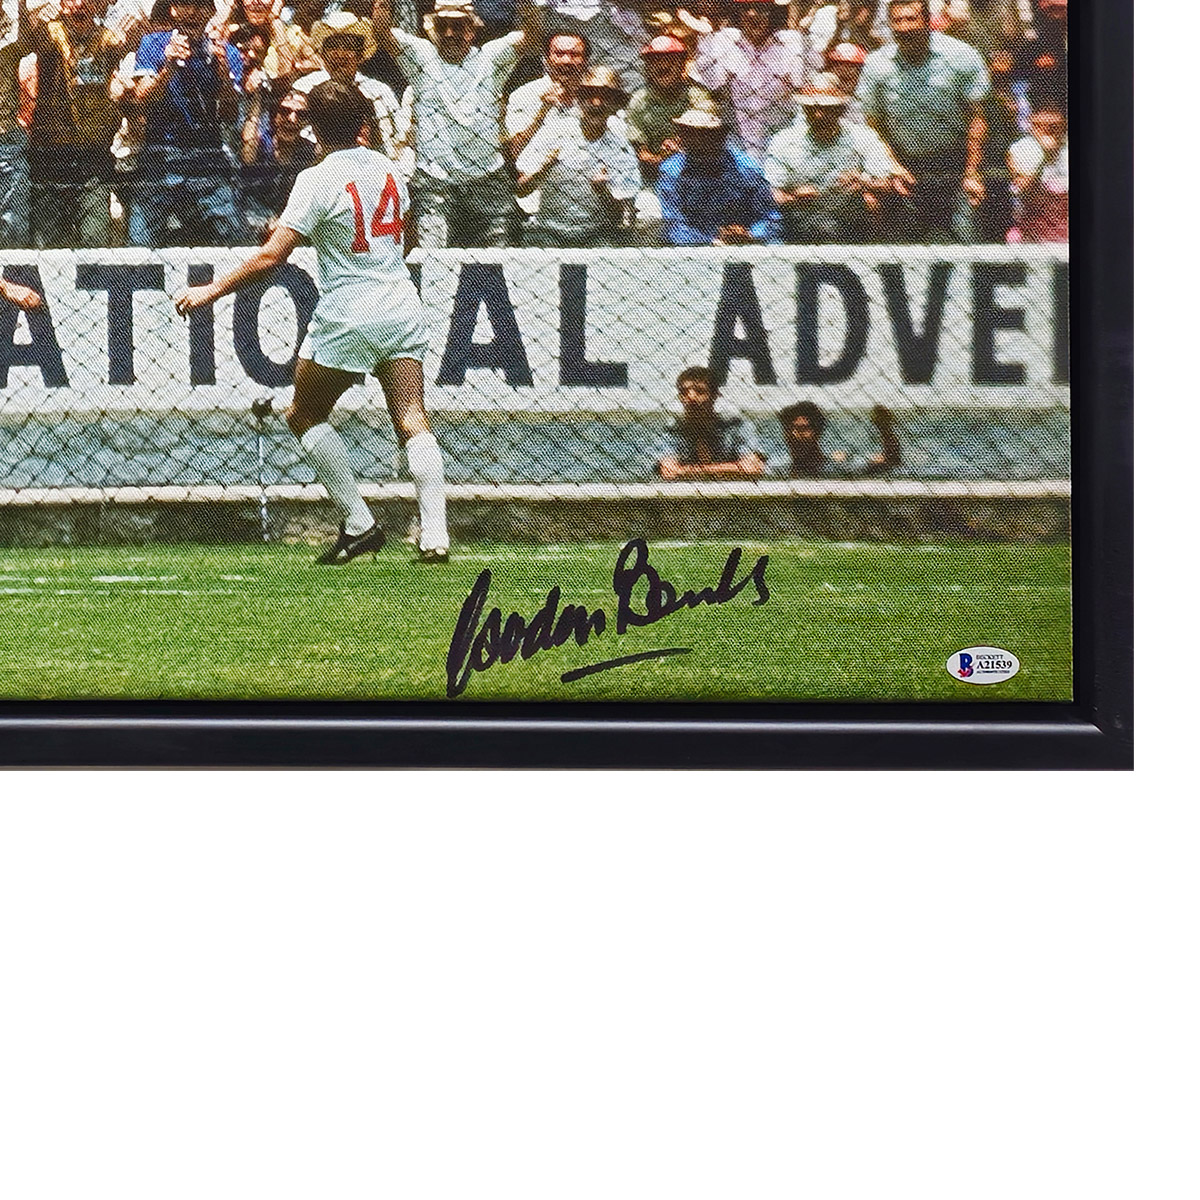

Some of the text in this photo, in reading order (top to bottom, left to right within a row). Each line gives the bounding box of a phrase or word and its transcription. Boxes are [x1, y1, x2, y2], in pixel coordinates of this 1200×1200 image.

[345, 172, 404, 253] 14
[707, 260, 1070, 388] ADVE
[976, 660, 1013, 669] A21539
